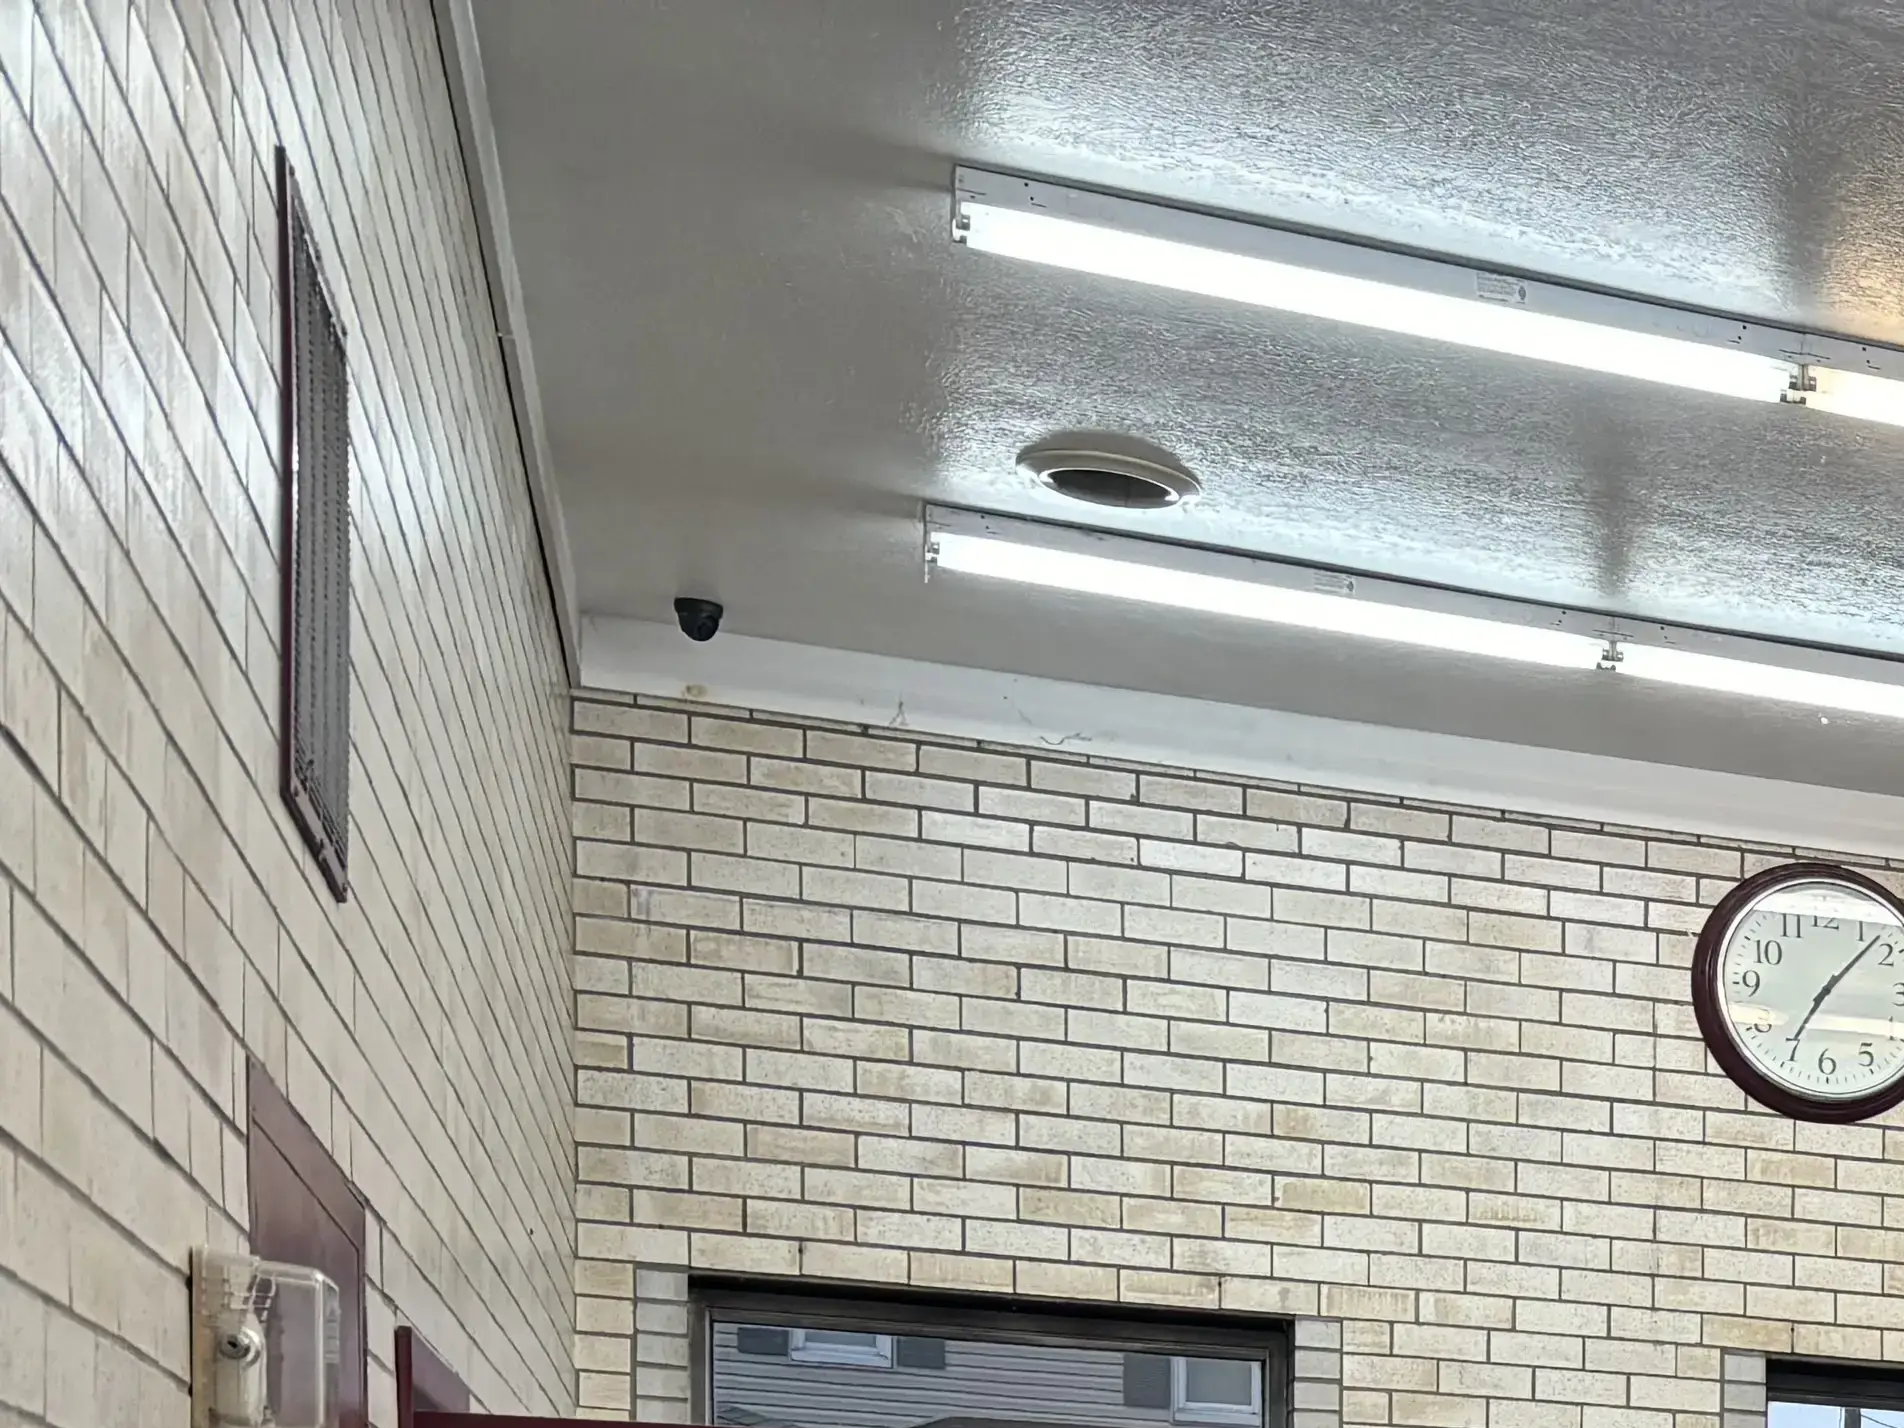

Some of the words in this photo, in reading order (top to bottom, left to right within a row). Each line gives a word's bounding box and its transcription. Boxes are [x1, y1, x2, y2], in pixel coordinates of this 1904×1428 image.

[1754, 939, 1782, 965] 10
[1878, 944, 1894, 966] 2
[1742, 970, 1761, 997] 9
[1786, 1037, 1800, 1062] 7
[1818, 1048, 1837, 1075] 6
[1859, 1042, 1874, 1067] 5
